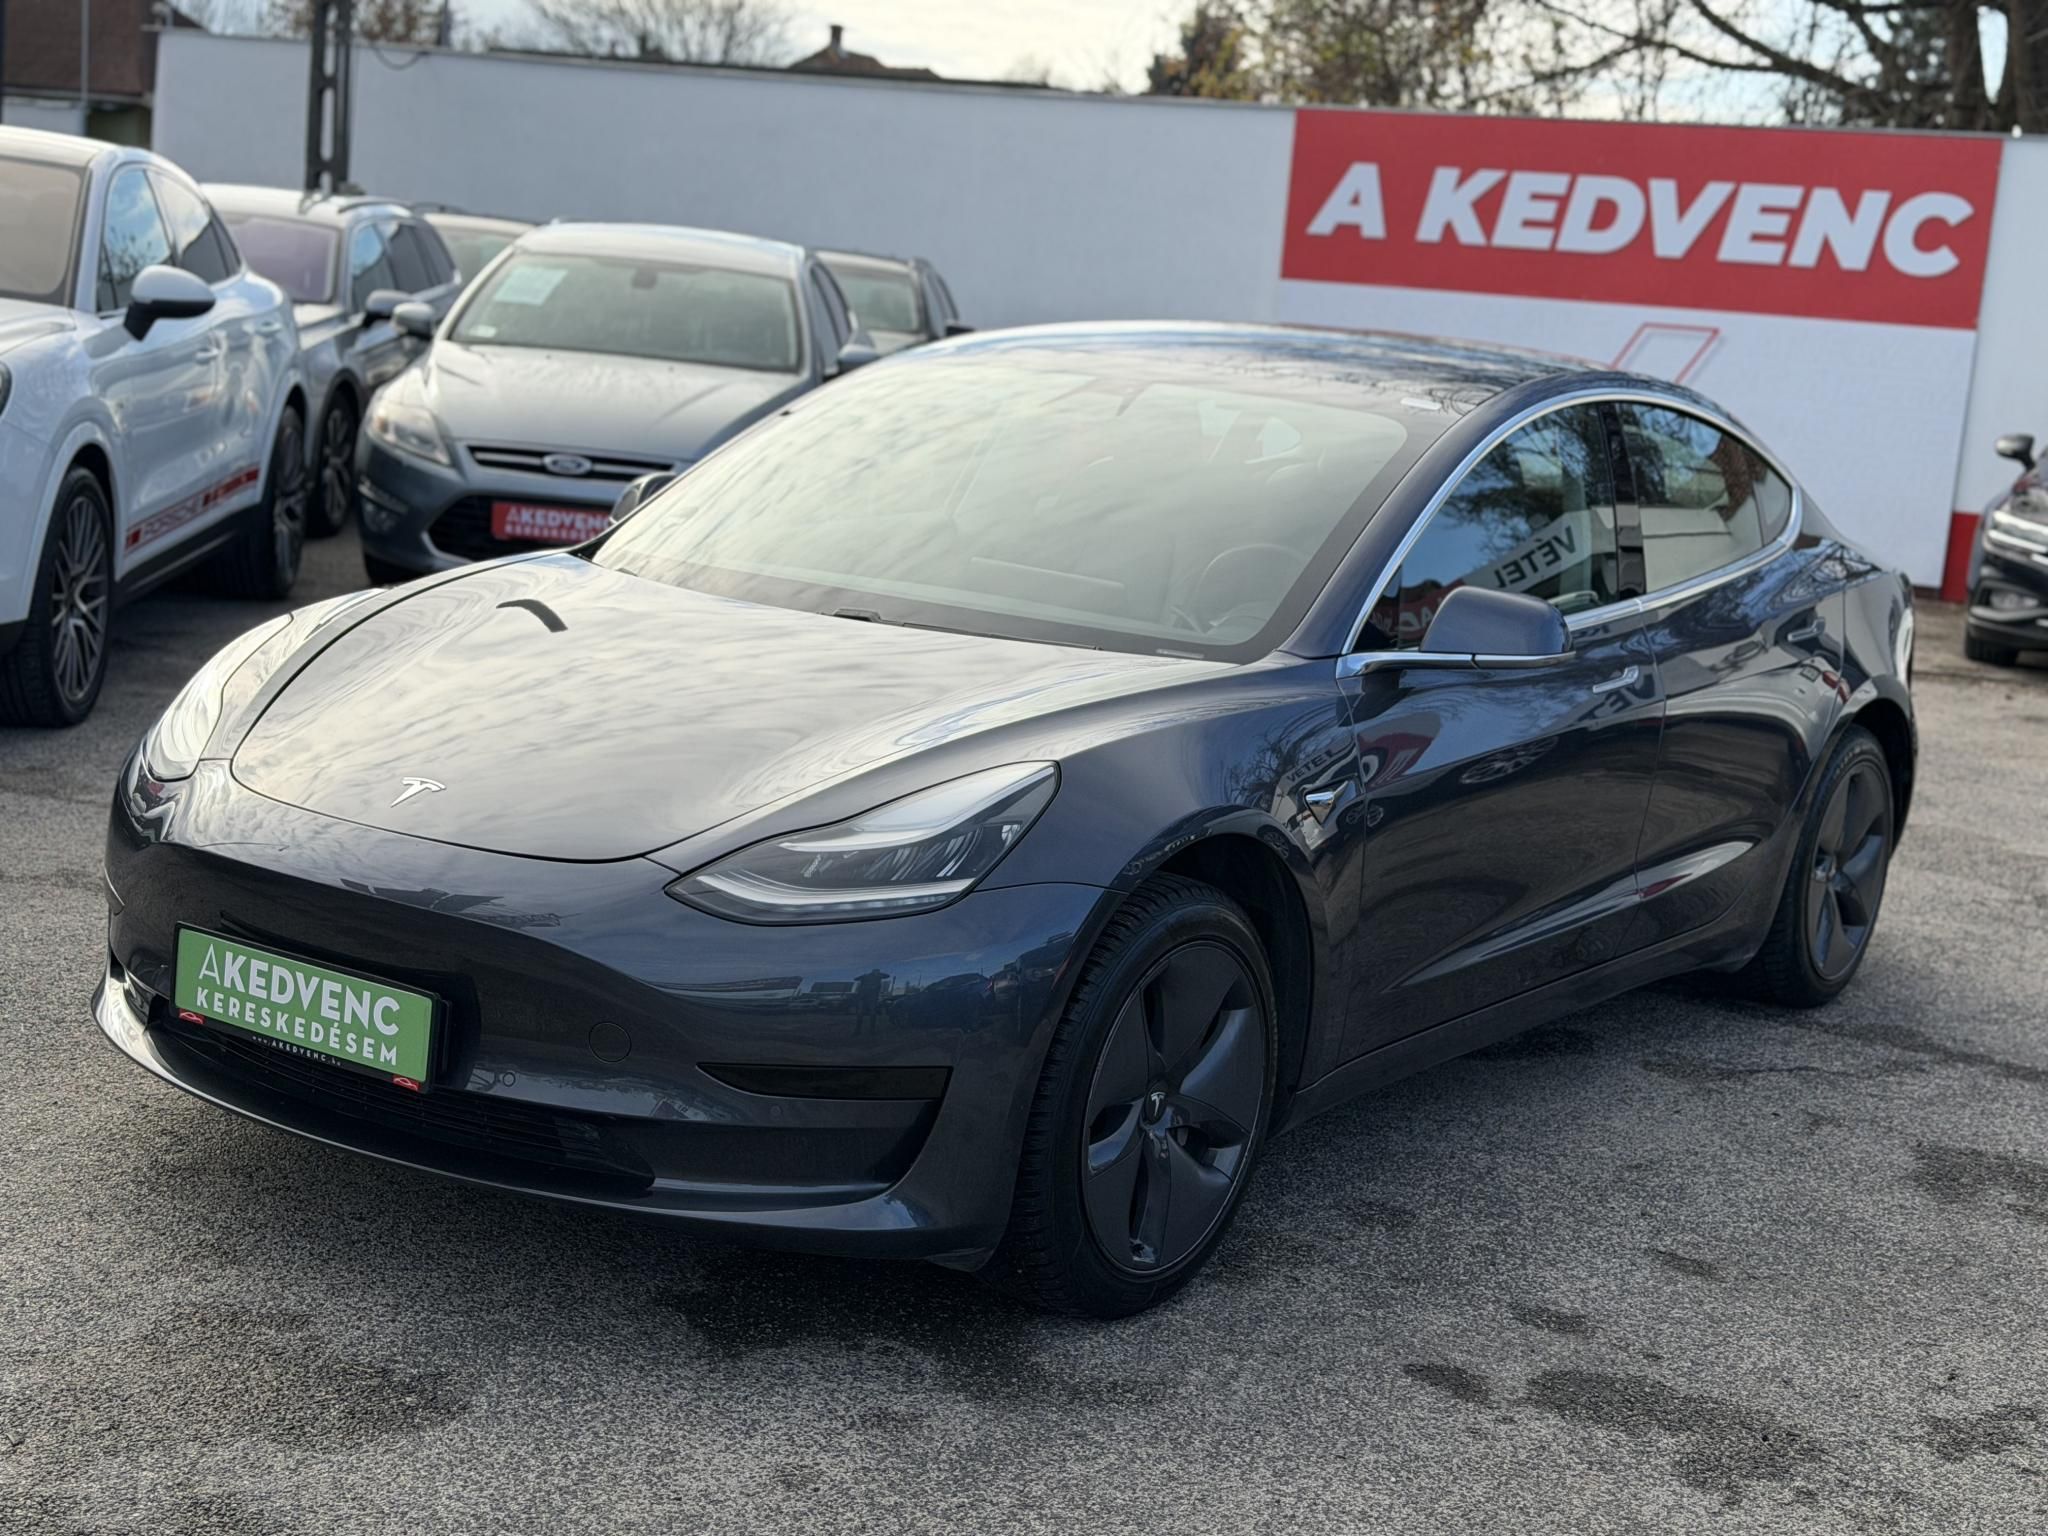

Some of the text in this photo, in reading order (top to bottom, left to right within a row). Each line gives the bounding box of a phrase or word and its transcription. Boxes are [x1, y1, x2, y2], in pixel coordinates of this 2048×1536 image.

[1307, 161, 1975, 278] A KEDVENC
[196, 986, 397, 1067] KERESKEDÉSEM
